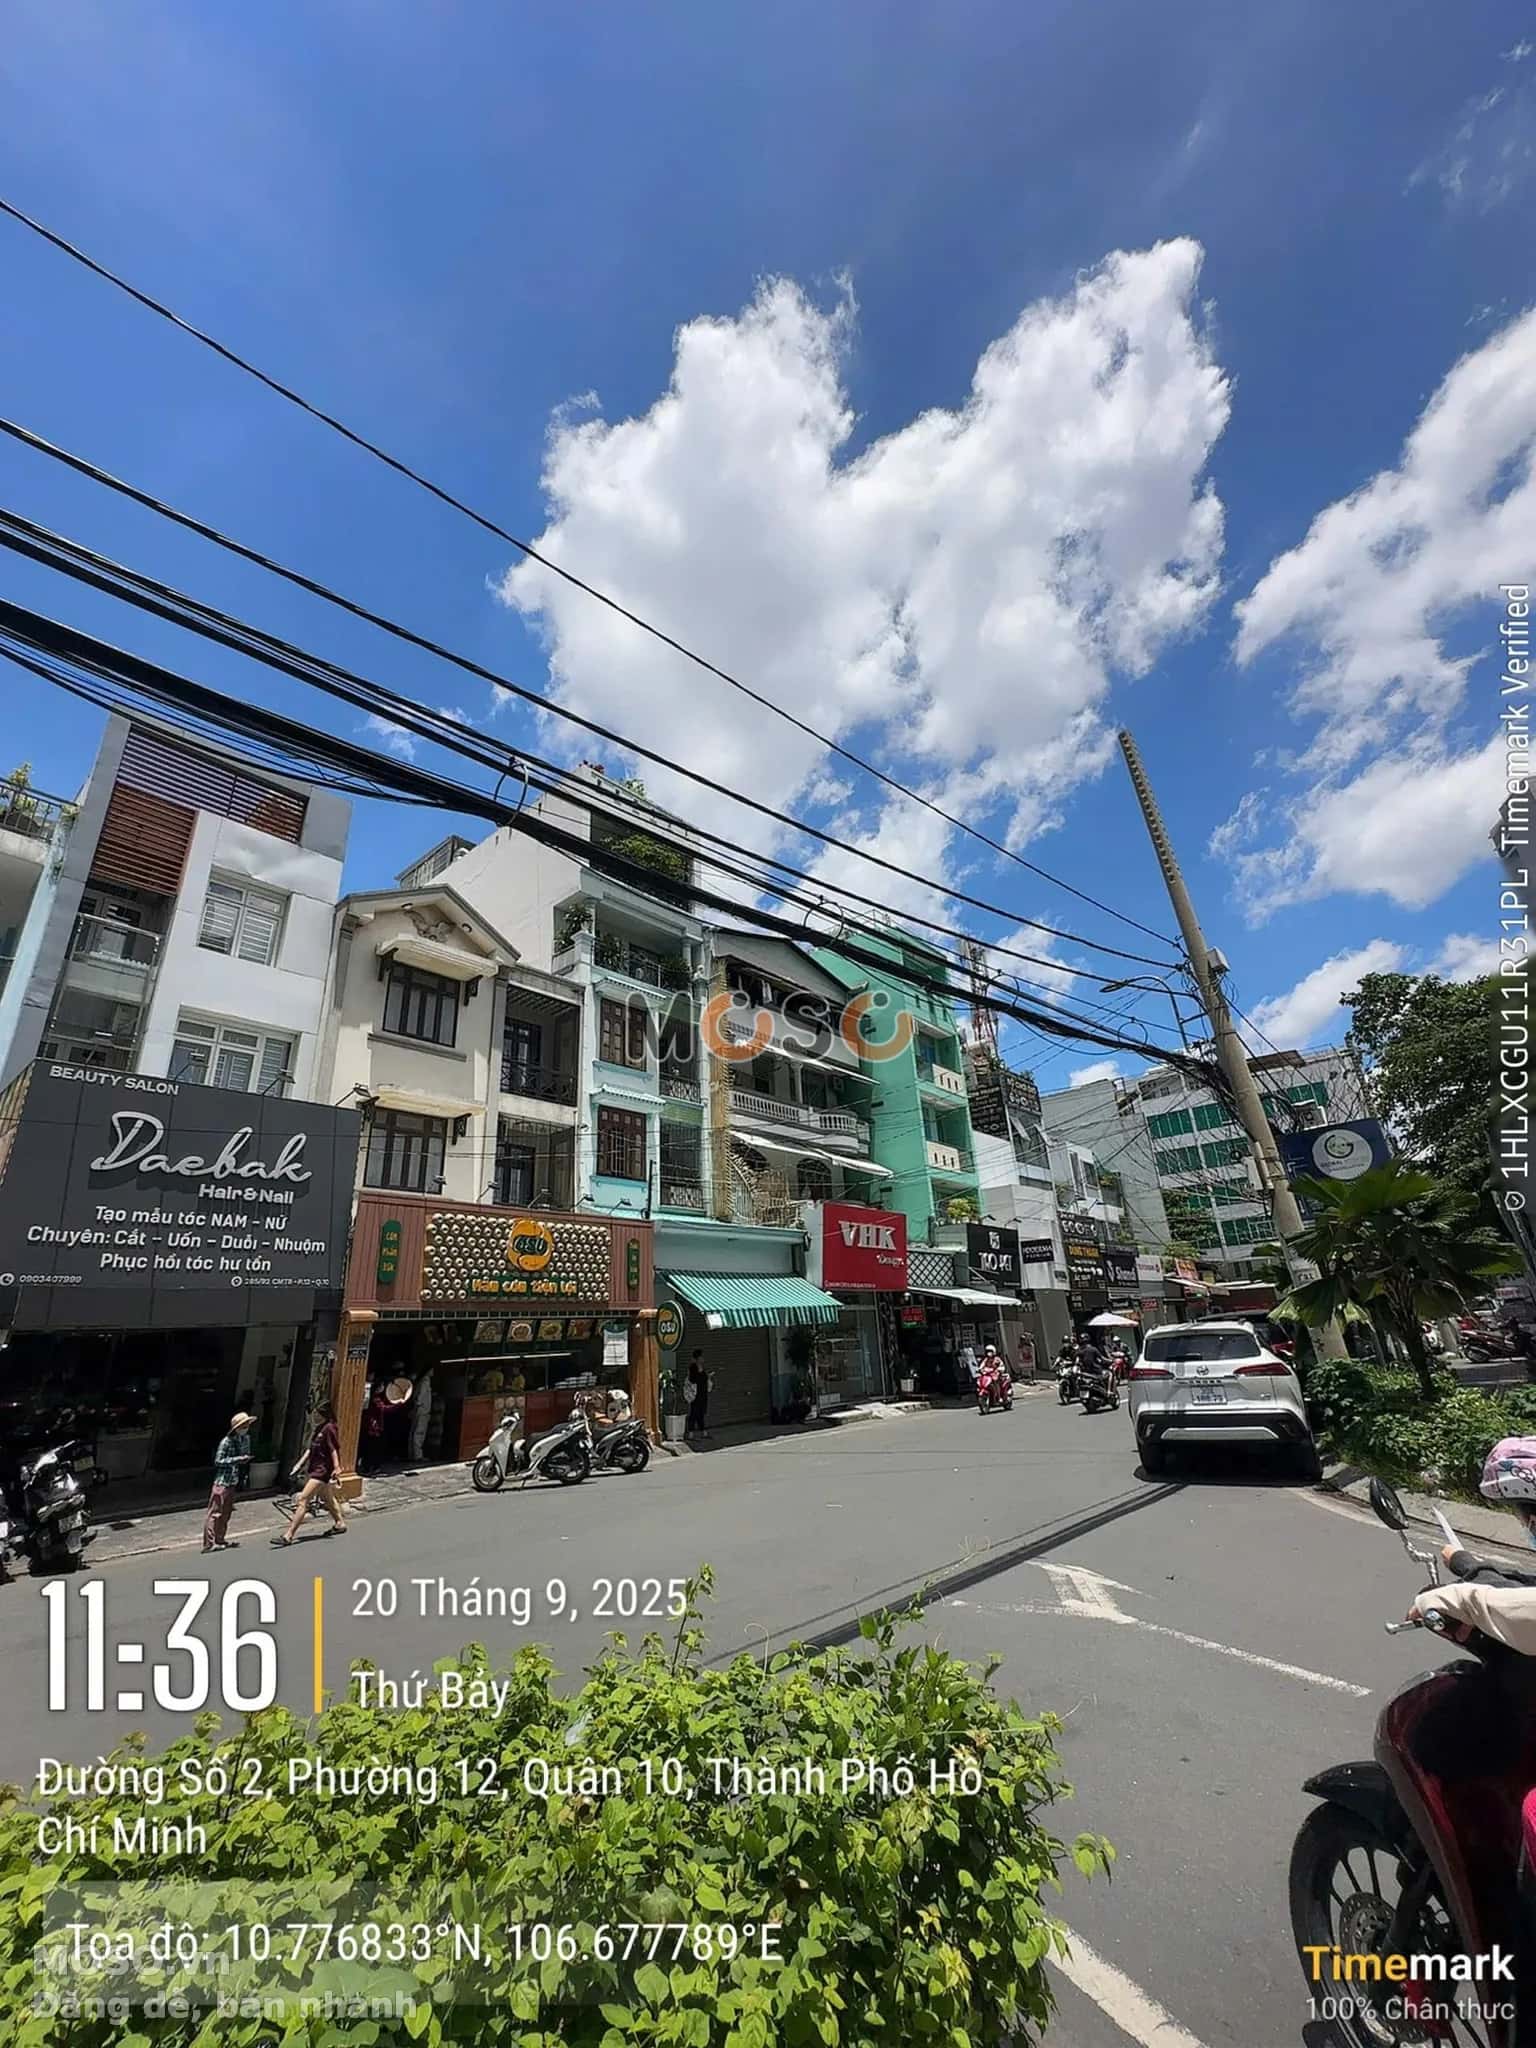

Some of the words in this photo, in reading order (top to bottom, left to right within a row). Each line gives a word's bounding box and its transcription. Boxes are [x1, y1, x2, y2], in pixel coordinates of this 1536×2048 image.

[50, 1065, 121, 1088] BEAUTY
[124, 1078, 180, 1096] SALON
[90, 1111, 313, 1183] Daebak
[96, 1205, 126, 1224] Tạo
[178, 1211, 206, 1227] tóc
[211, 1213, 248, 1228] NAM
[27, 1225, 111, 1246] Chuyên:
[114, 1228, 146, 1246] Cắt
[168, 1232, 201, 1248] Uốn
[274, 1237, 326, 1254] Nhuộm
[838, 1220, 896, 1250] VHK
[100, 1253, 148, 1271] Phục
[186, 1255, 213, 1271] tóc
[219, 1256, 242, 1271] hư
